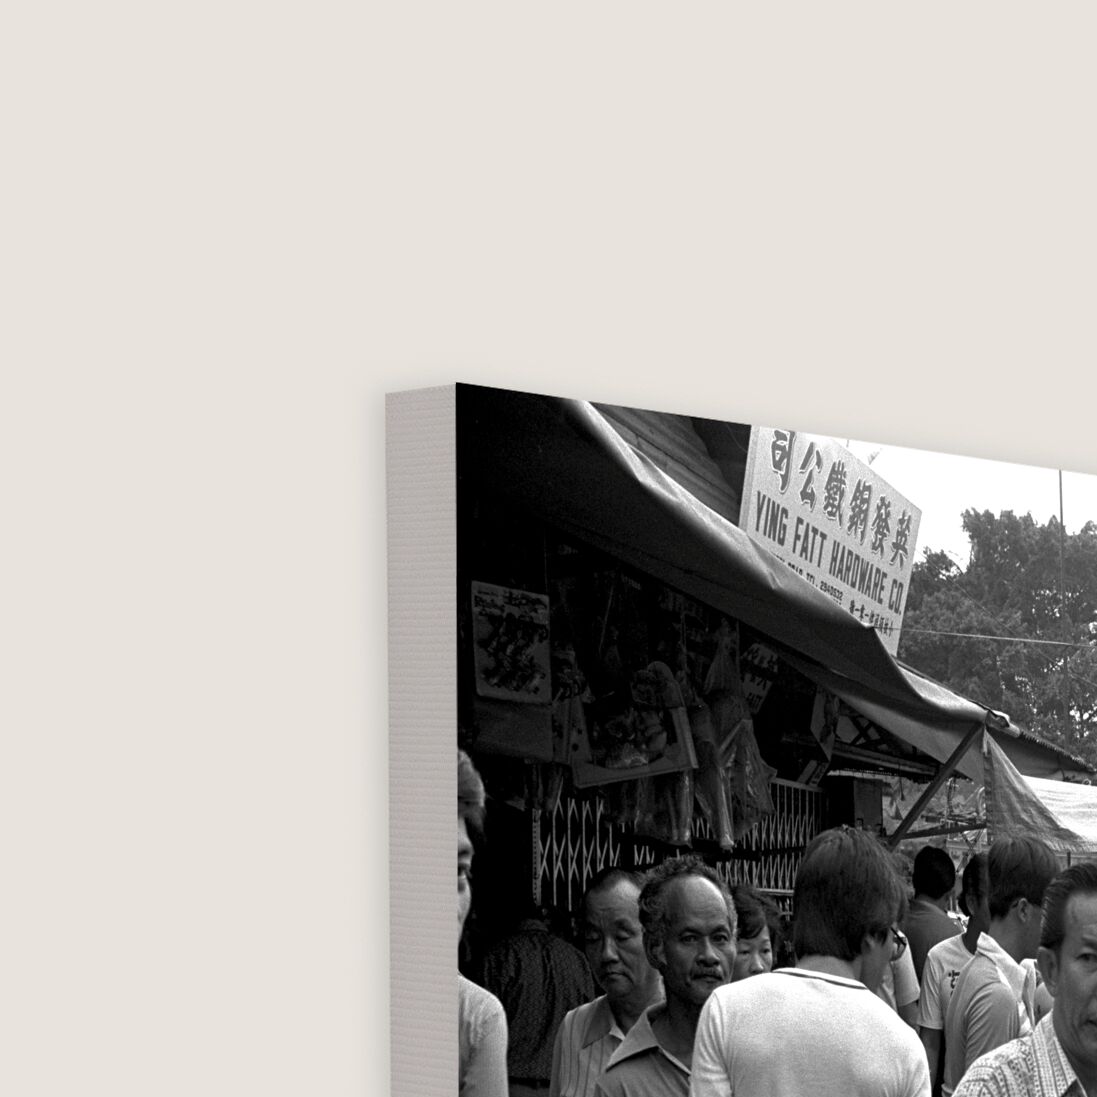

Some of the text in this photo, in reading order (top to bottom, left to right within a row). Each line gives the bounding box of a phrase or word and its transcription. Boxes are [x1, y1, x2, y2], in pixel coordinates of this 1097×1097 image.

[755, 490, 789, 547] YING
[792, 516, 828, 568] FATT
[828, 540, 888, 605] HARDWARE
